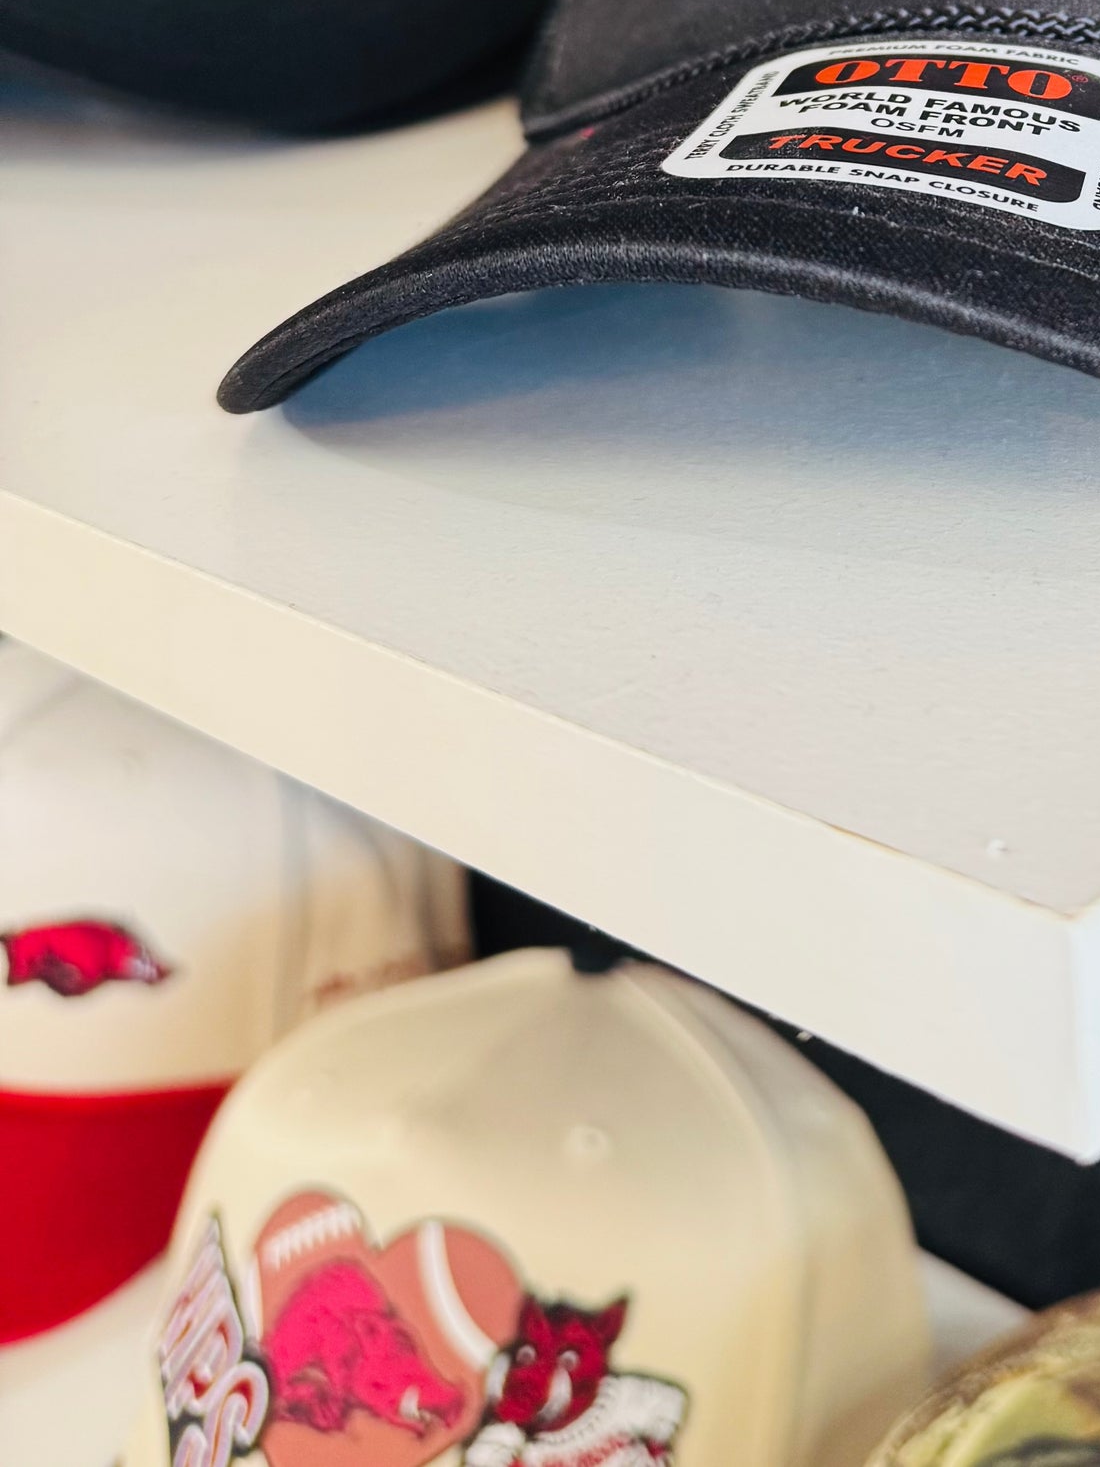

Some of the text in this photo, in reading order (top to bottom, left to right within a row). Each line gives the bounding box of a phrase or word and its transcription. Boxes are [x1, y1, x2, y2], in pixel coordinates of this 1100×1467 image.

[828, 44, 1080, 66] PREMIUM FOAM FABRIC
[708, 114, 744, 137] CLOTH
[779, 91, 1081, 133] WORLD FAMOUS
[798, 101, 1051, 136] FOAM FRONT
[870, 118, 965, 138] OSFM
[768, 134, 1048, 186] TRUCKER
[726, 164, 1040, 212] DURABLE SNAP CLOSURE
